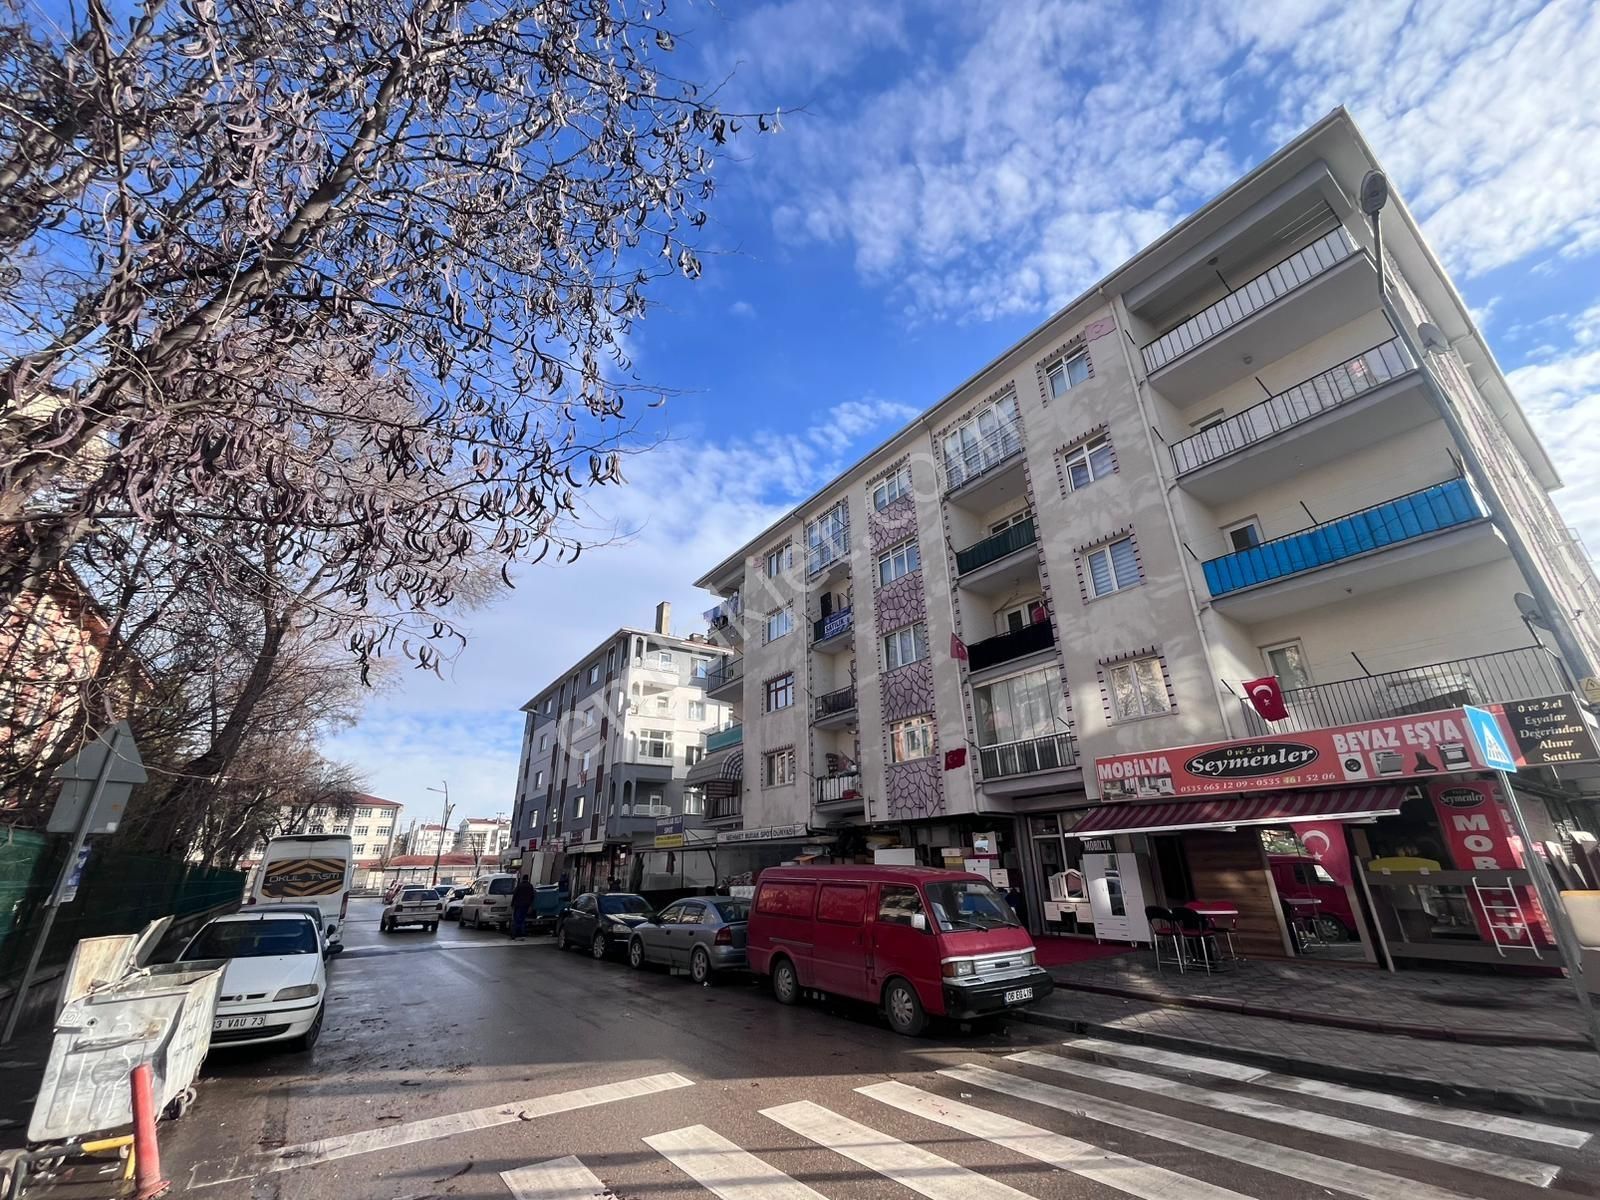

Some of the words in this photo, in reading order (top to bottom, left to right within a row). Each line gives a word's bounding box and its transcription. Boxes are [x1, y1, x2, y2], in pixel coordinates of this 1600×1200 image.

[1517, 704, 1525, 713] 0
[1332, 726, 1401, 754] BEYAZ
[1401, 719, 1463, 750] EŞYA
[1191, 748, 1313, 776] Seymenler
[1181, 785, 1201, 793] 0535
[1203, 782, 1220, 791] 665
[1236, 780, 1248, 788] 09
[1256, 778, 1280, 786] 0535
[1306, 774, 1319, 782] 52
[1322, 772, 1336, 780] 06
[1440, 791, 1484, 805] Seymenler
[269, 873, 302, 883] OKUL
[228, 1018, 247, 1028] VAU
[250, 1017, 264, 1026] 73
